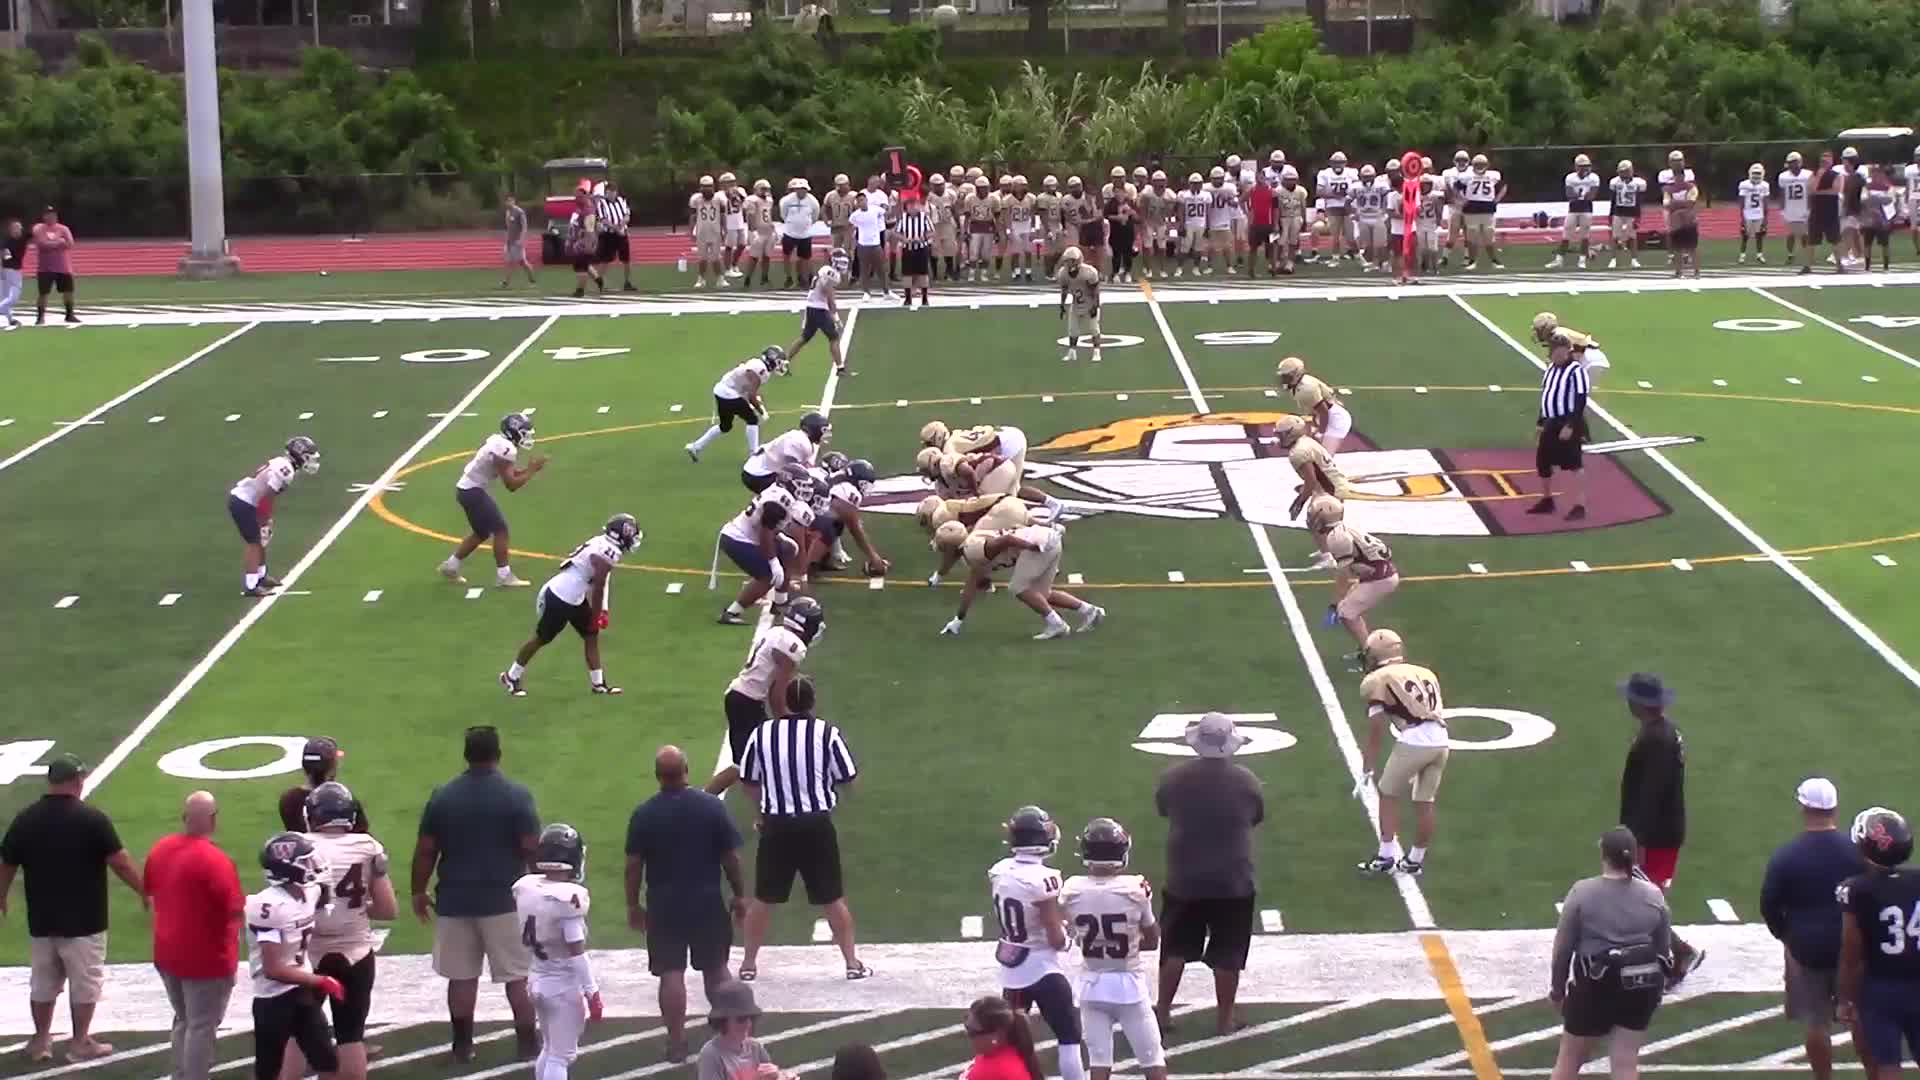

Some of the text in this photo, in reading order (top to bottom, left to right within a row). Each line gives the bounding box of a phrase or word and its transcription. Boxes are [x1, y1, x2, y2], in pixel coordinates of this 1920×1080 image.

[889, 152, 901, 175] 1
[1472, 181, 1490, 195] 75
[1788, 184, 1803, 200] 12
[1751, 194, 1759, 208] 5
[1187, 203, 1204, 217] 20
[1043, 876, 1059, 893] 10
[260, 903, 271, 919] 5
[994, 894, 1027, 943] 10
[523, 914, 548, 960] 4
[1075, 914, 1129, 959] 25
